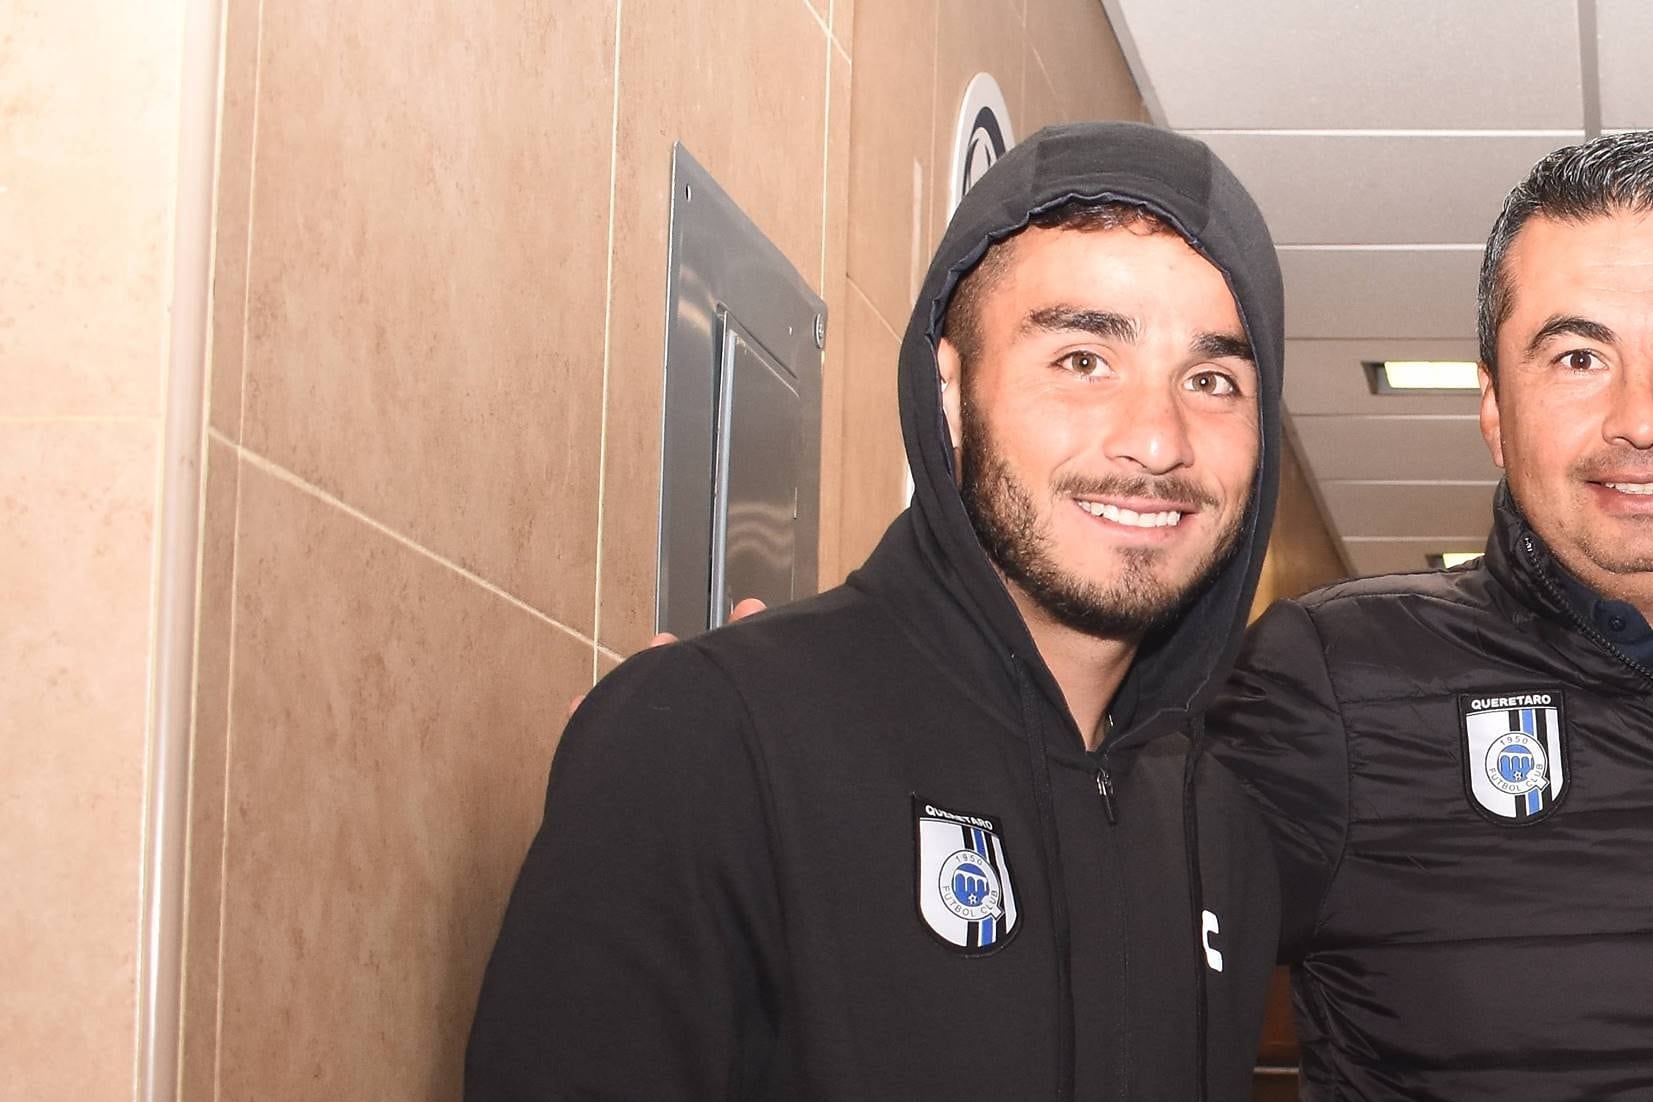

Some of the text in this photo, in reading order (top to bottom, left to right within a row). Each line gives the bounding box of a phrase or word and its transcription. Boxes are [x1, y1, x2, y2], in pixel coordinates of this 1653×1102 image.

[1471, 694, 1551, 710] QUERETARO
[1500, 735, 1529, 746] 1950
[1489, 763, 1543, 792] FUTBOL CLUB
[925, 804, 993, 831] QUERETARO
[955, 853, 983, 866] 1950
[942, 885, 998, 917] FUTBOL CLUB
